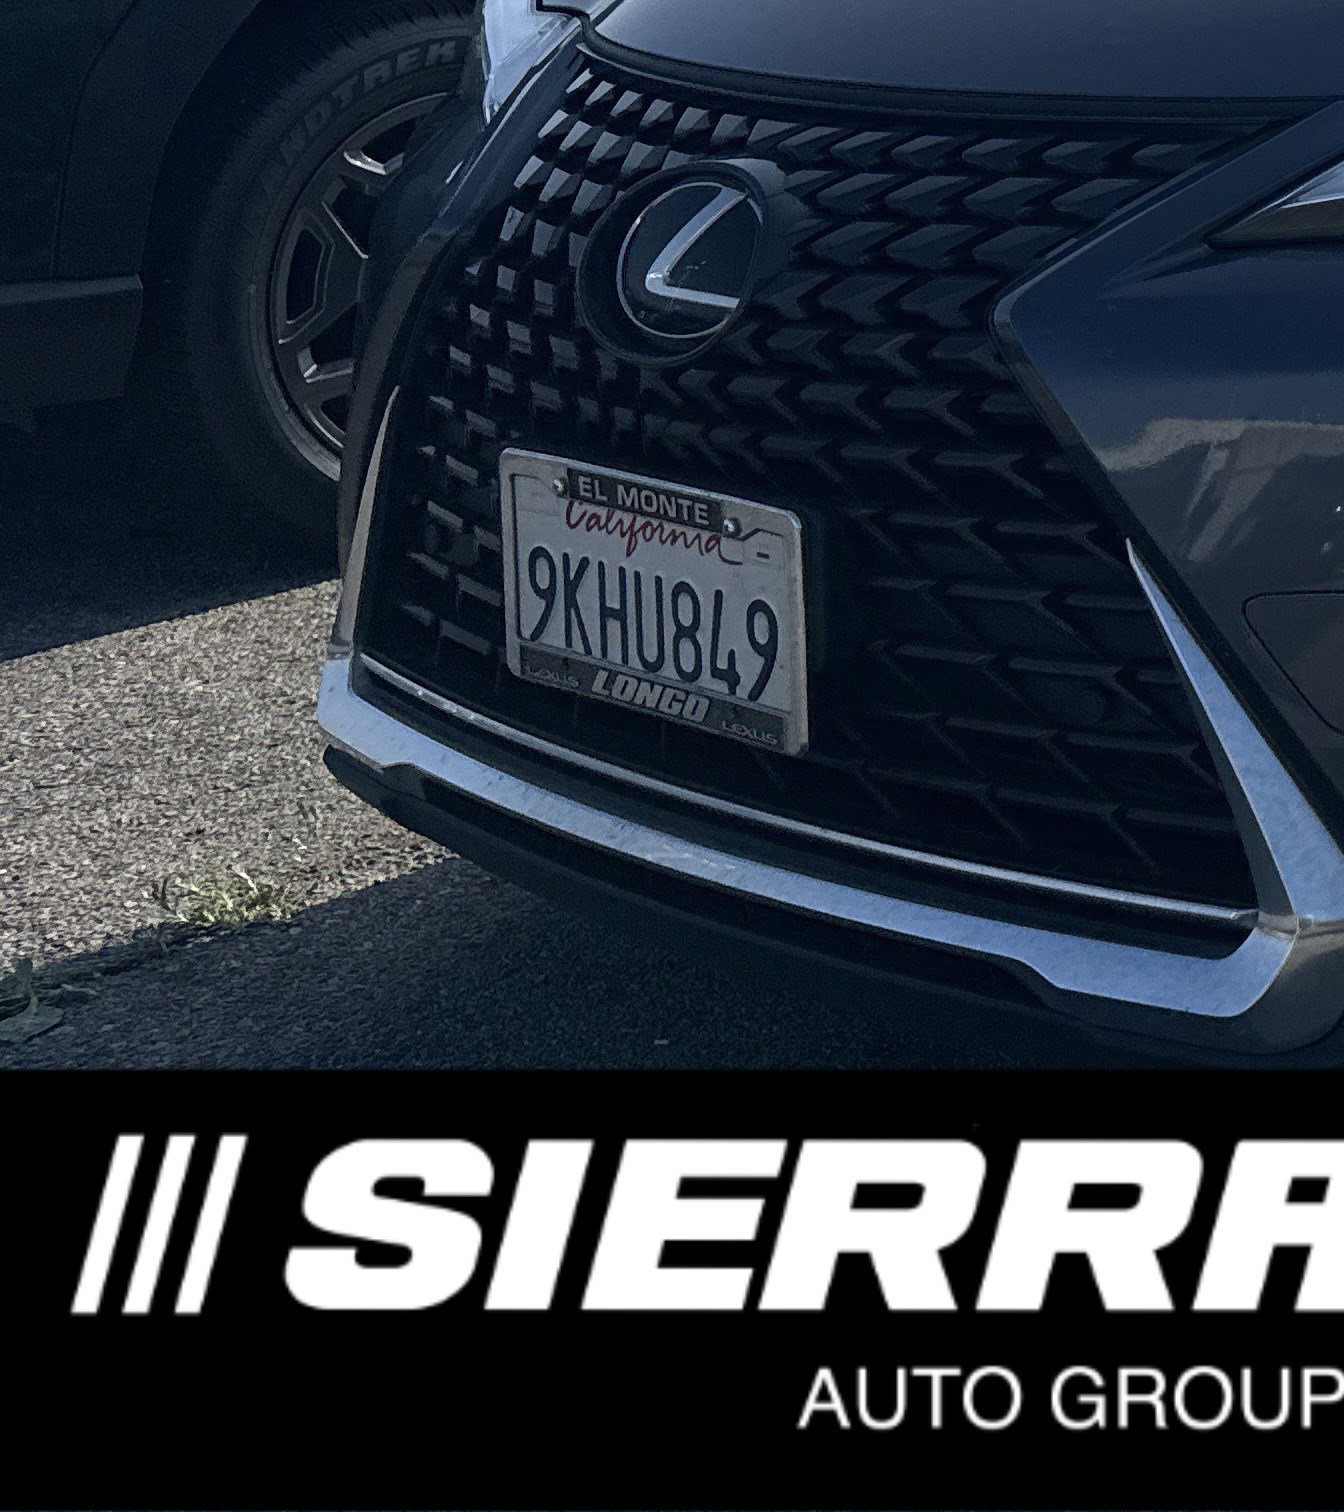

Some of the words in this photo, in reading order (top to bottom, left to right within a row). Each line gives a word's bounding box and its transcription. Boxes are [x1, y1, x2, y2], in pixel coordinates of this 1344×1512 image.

[577, 475, 608, 502] EL
[616, 484, 710, 526] MONTE
[565, 500, 744, 566] California
[527, 545, 779, 702] 9KHU849
[591, 669, 711, 723] LONGO
